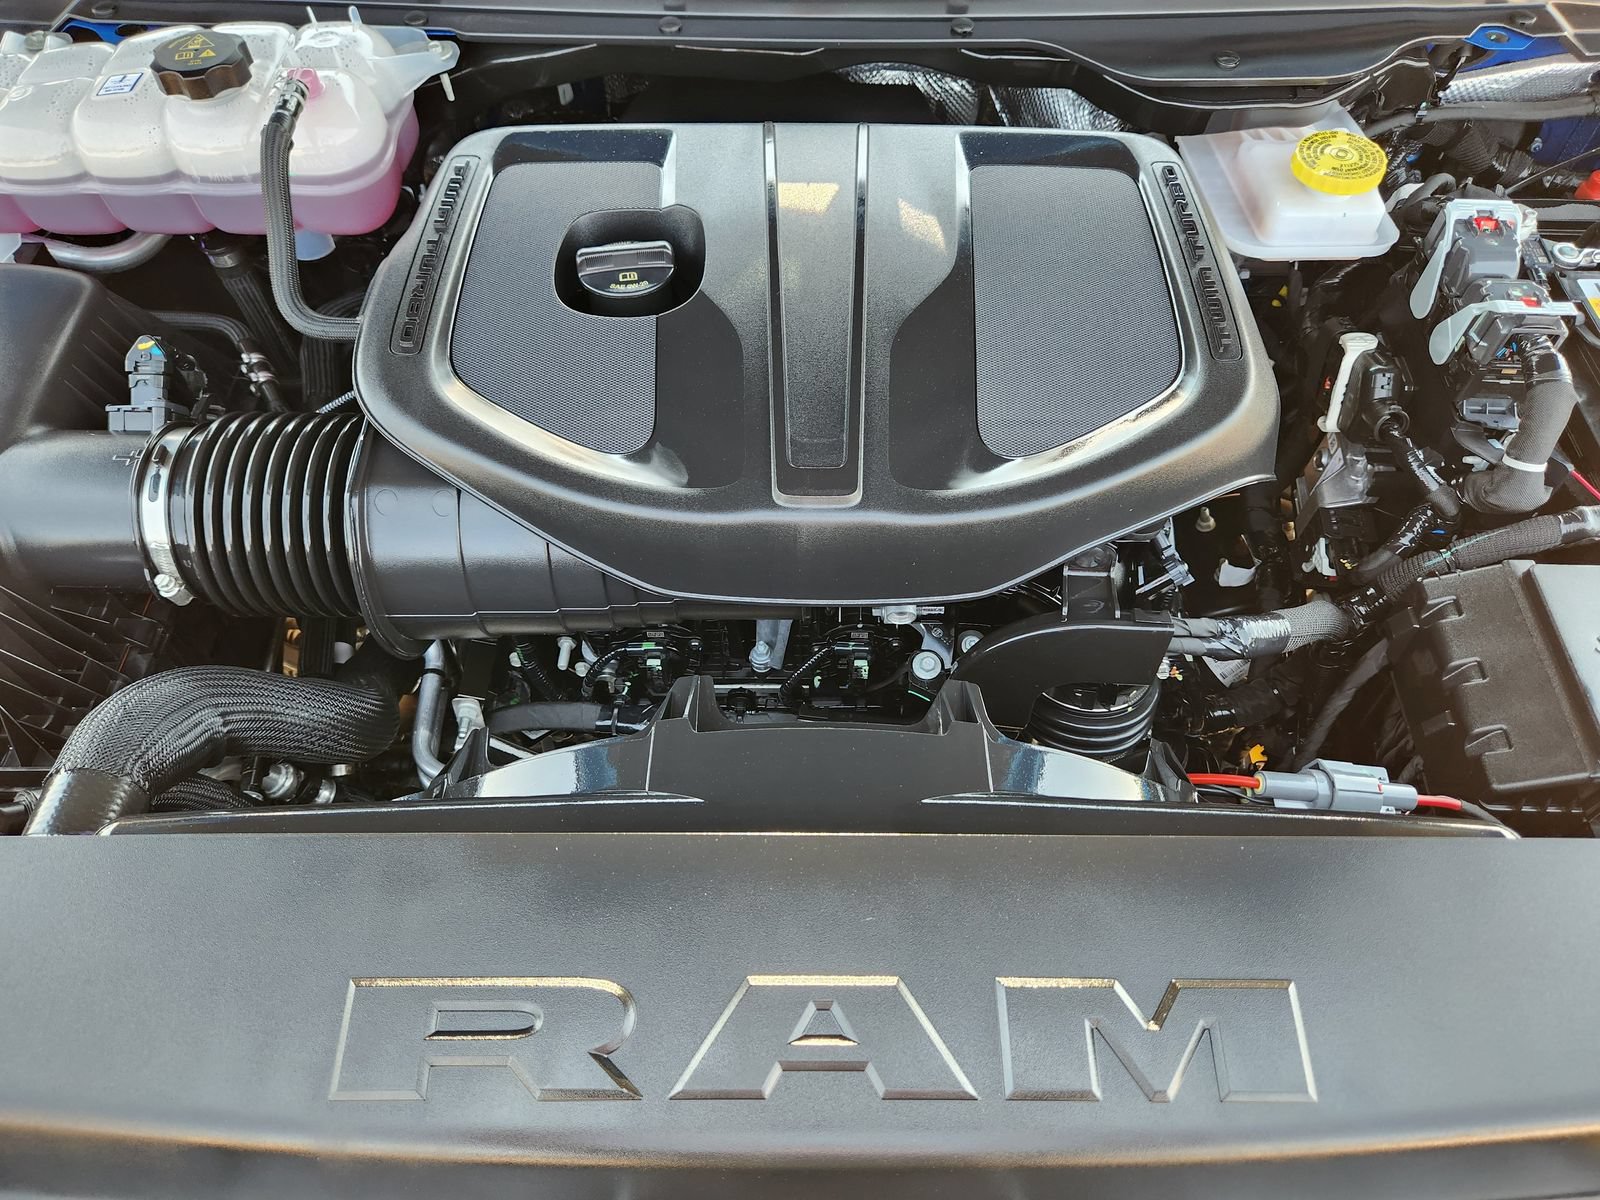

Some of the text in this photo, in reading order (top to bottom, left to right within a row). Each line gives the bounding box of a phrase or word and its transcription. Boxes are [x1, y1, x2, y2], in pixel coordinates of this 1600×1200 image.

[399, 160, 470, 348] TWIN TURBO
[1161, 165, 1233, 353] TWIN TURBO
[329, 975, 1319, 1101] RAM
